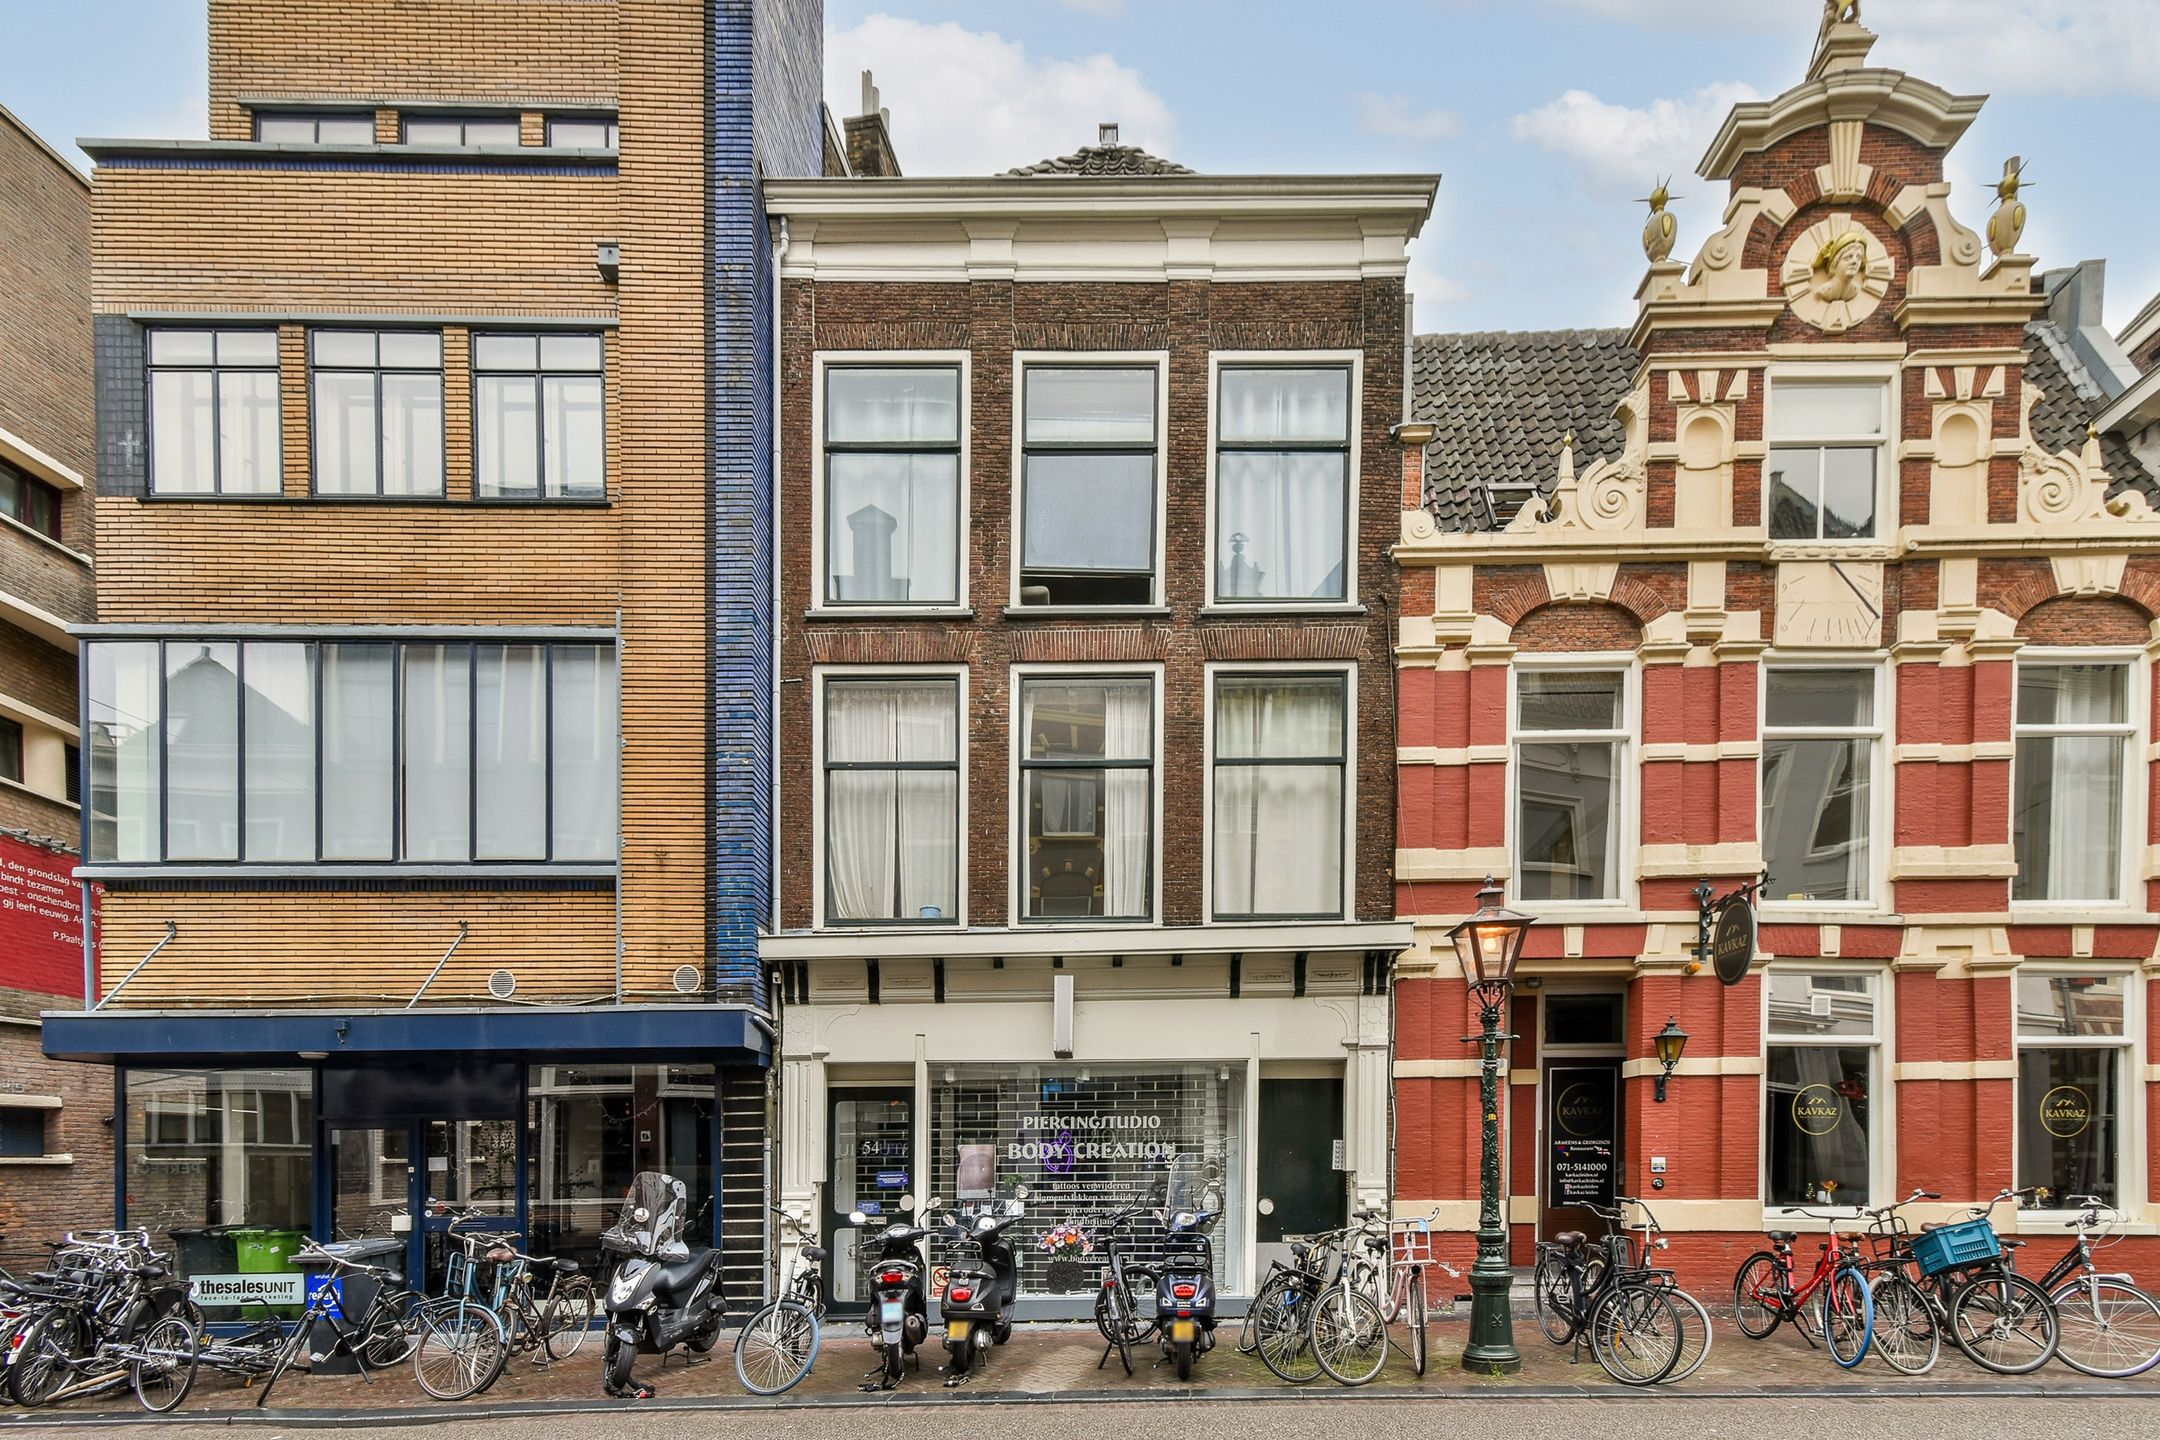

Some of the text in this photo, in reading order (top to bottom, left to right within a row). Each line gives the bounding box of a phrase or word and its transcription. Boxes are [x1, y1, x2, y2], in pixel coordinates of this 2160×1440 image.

[8, 861, 25, 873] den
[27, 868, 70, 886] grondslag
[1, 871, 64, 896] bindt tezamen
[27, 892, 81, 912] onschendbre
[3, 898, 14, 910] gij
[16, 900, 37, 913] leeft
[39, 909, 71, 922] eeuwig.
[1717, 934, 1748, 955] KAVKAZ
[1562, 1106, 1605, 1116] KAVKAZ
[1797, 1107, 1837, 1116] KAVKAZ
[2045, 1109, 2086, 1118] KAVKAZ
[1023, 1115, 1161, 1129] PIERCINGSTUDIO
[862, 1141, 880, 1155] 54
[1008, 1142, 1176, 1160] BODY CREATION
[1556, 1163, 1608, 1171] 071-5141000
[1052, 1182, 1080, 1190] tattoos
[200, 1279, 296, 1294] thesalesUNIT
